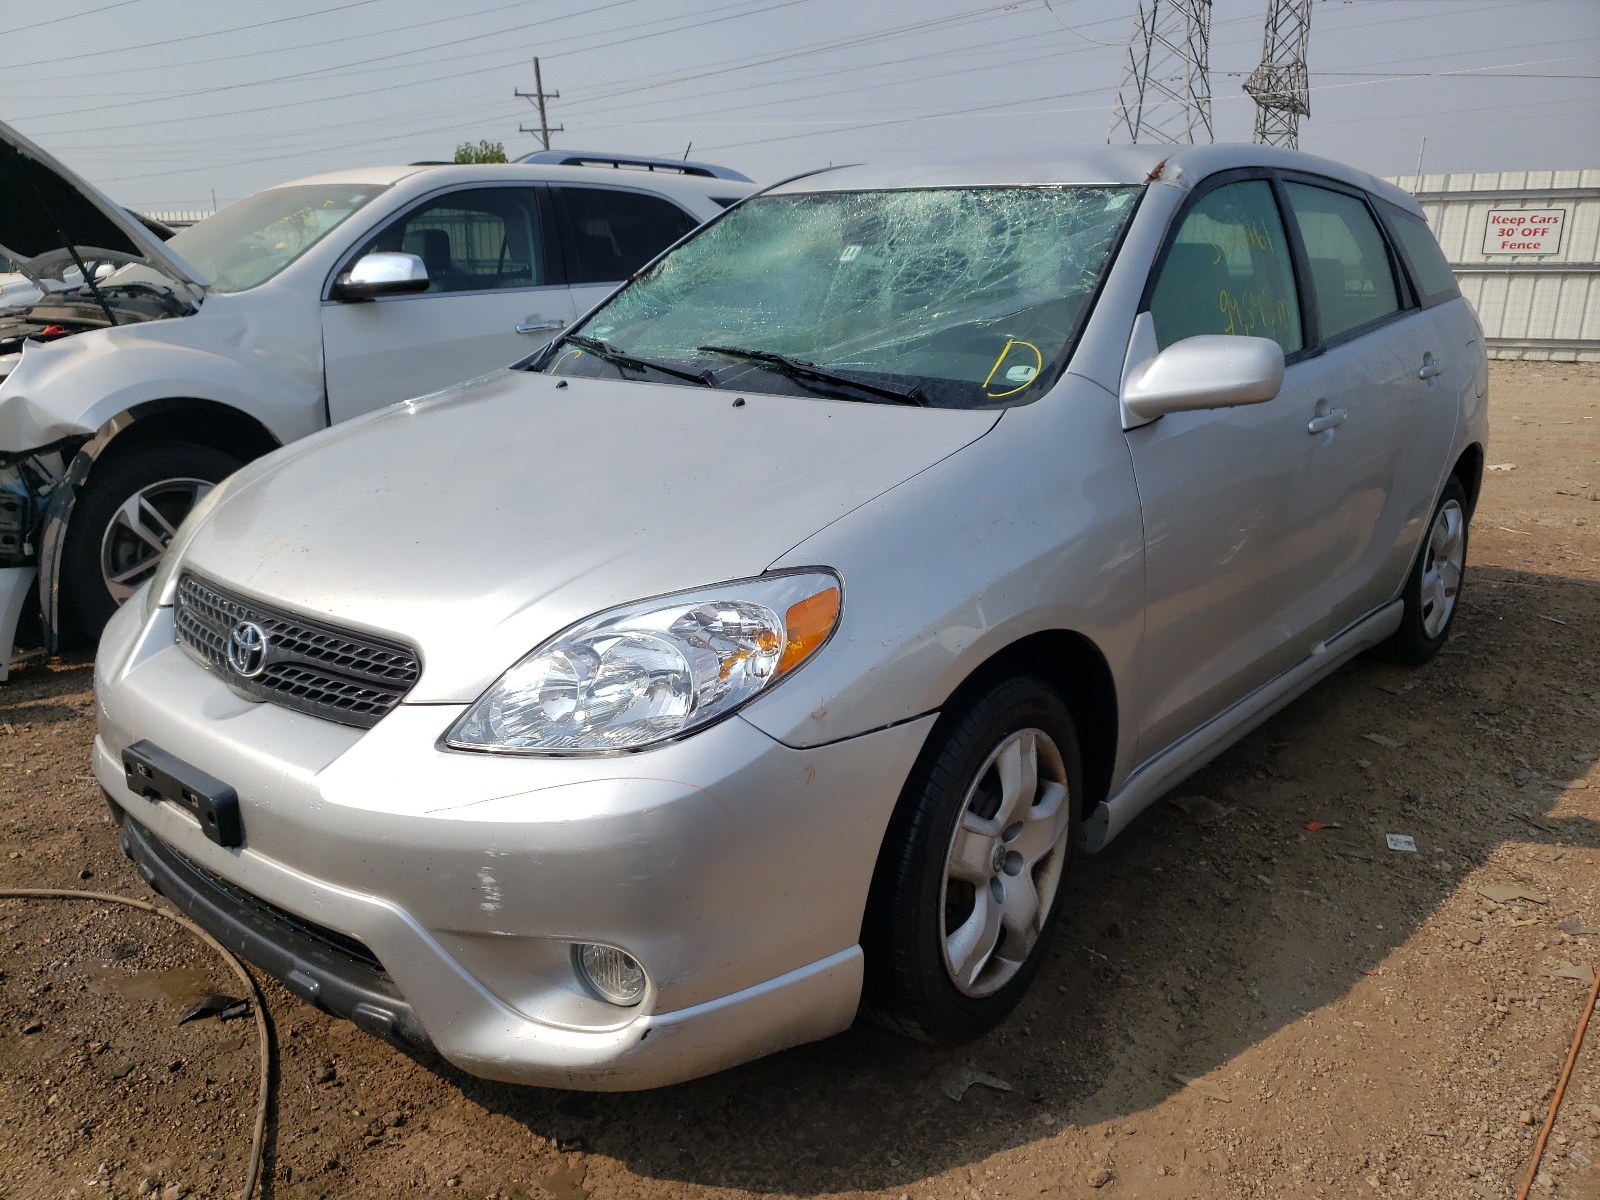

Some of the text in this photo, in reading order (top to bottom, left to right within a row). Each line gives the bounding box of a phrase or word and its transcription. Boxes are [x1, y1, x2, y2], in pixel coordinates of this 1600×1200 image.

[1491, 214, 1560, 226] Keep Cars
[1521, 227, 1550, 237] OFF
[1501, 240, 1541, 249] Fence
